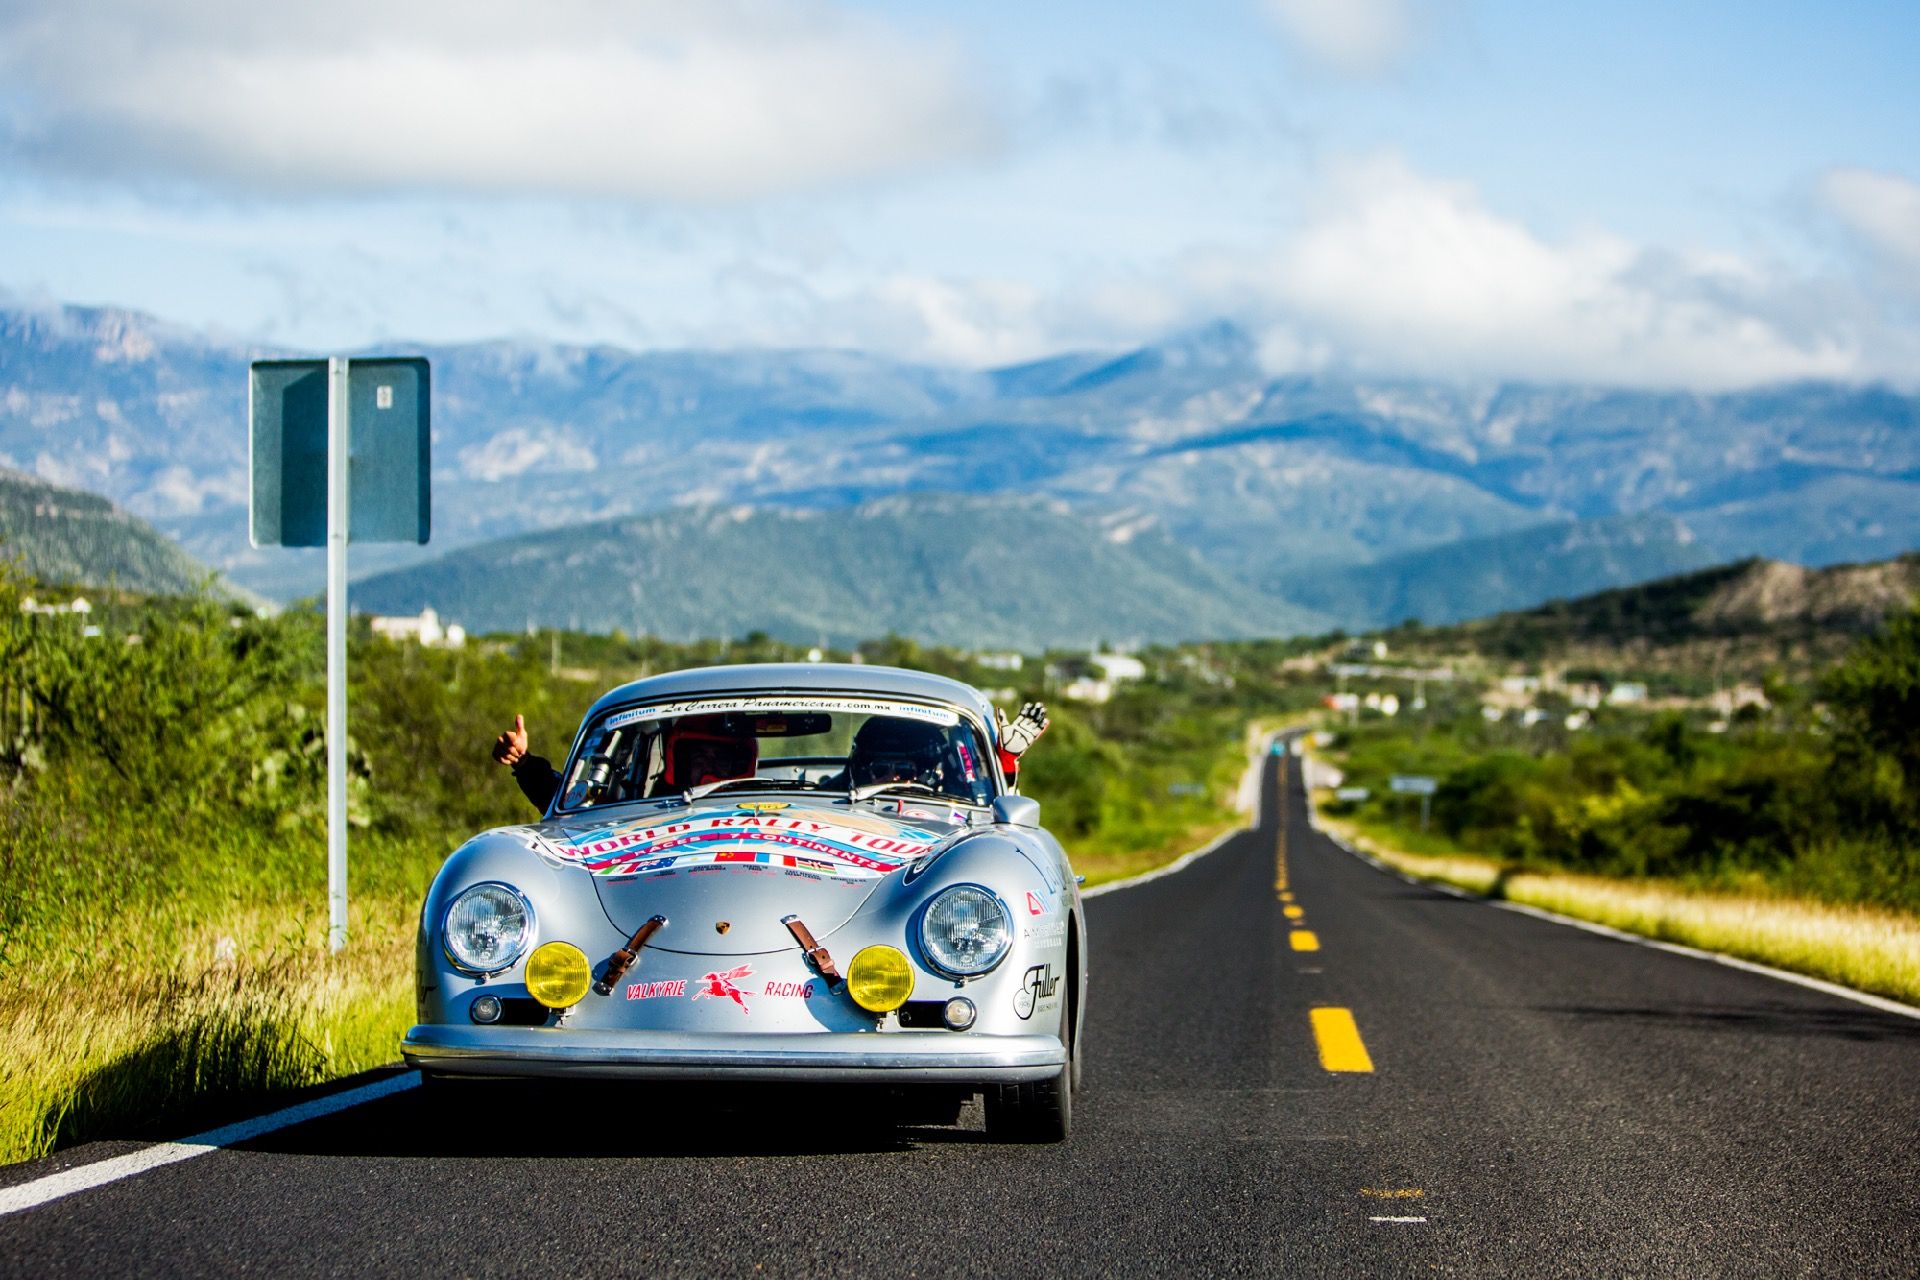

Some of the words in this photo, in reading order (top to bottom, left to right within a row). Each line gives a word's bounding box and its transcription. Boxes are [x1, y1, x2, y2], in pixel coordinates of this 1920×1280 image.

[609, 707, 656, 724] infinitum
[661, 702, 681, 713] La
[685, 699, 737, 712] Carrera
[899, 705, 949, 719] infinitum
[556, 823, 691, 857] WORLD
[710, 817, 831, 833] RALLY
[634, 835, 701, 857] RACES
[769, 833, 901, 869] CONTINENTS
[626, 979, 688, 1001] VALKYRIE
[764, 981, 814, 999] RACING
[1012, 963, 1060, 1021] Fuller
